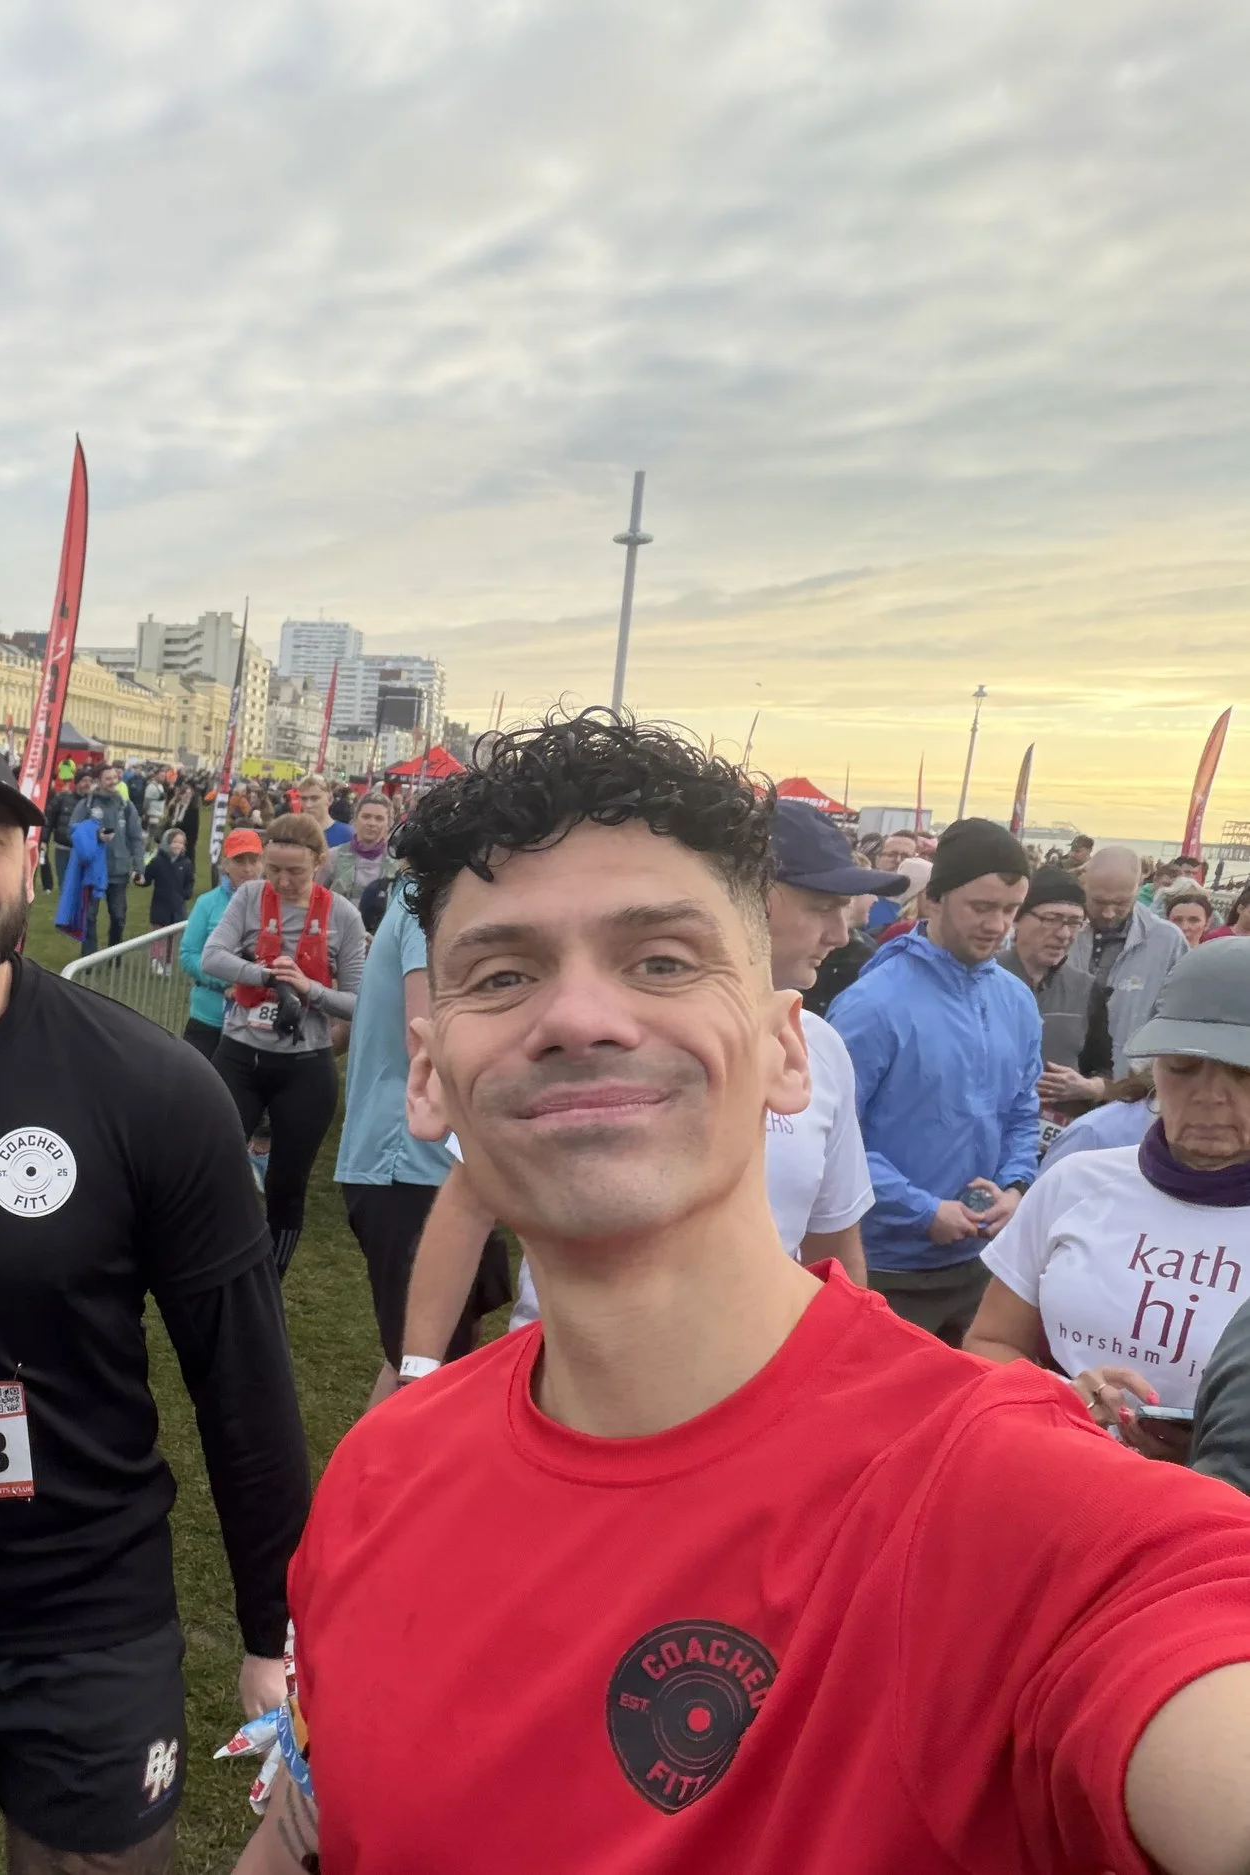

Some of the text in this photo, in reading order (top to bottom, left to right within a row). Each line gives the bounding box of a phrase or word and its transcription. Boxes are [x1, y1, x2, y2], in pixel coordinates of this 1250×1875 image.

[0, 1135, 64, 1161] COACHED
[57, 1168, 68, 1177] 25
[13, 1194, 48, 1209] FITT
[1127, 1232, 1243, 1293] kath
[1130, 1280, 1200, 1364] hj
[1059, 1322, 1161, 1366] horsham
[645, 1760, 706, 1802] FITT
